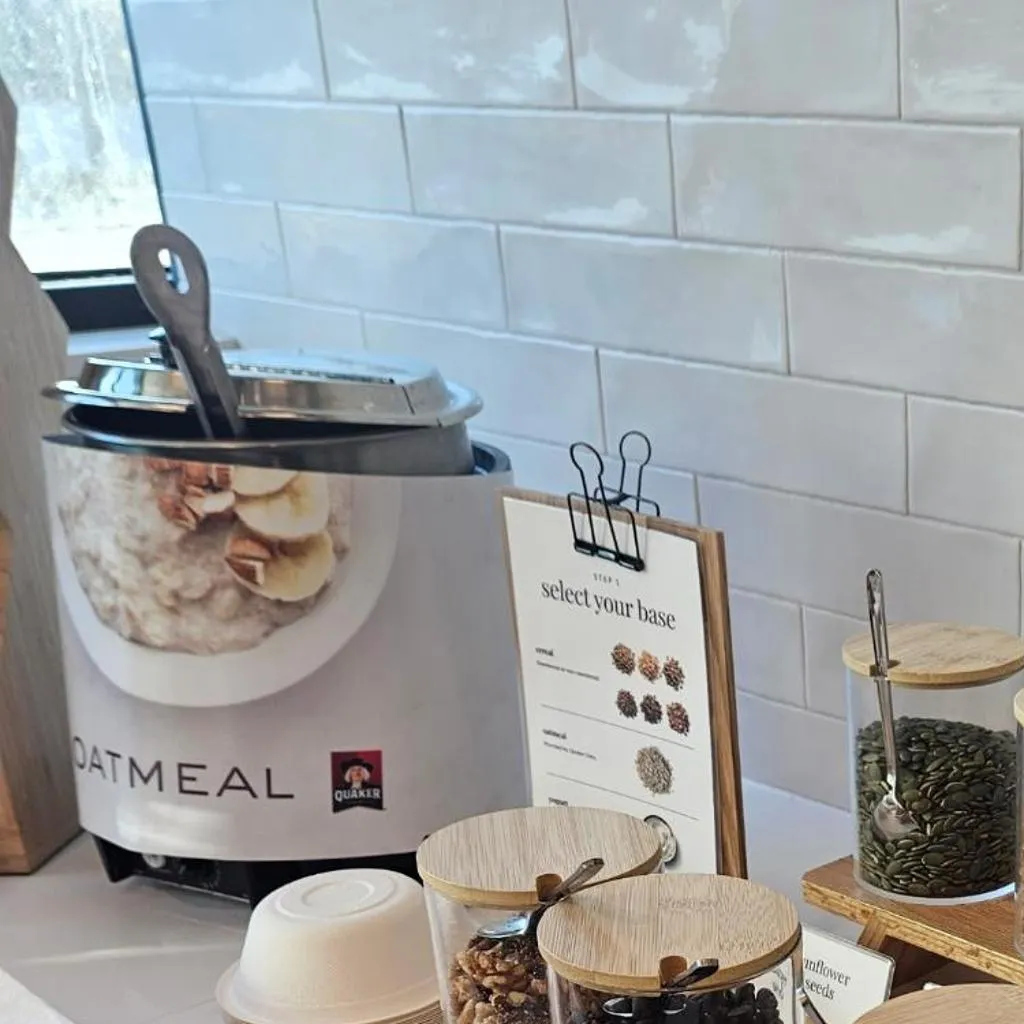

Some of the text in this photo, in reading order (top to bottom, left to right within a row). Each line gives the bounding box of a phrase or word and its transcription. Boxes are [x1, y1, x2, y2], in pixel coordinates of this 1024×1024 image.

[541, 579, 676, 630] select your base
[72, 736, 295, 799] OATMEAL
[334, 787, 381, 802] QUAKER
[805, 979, 835, 1000] seeds
